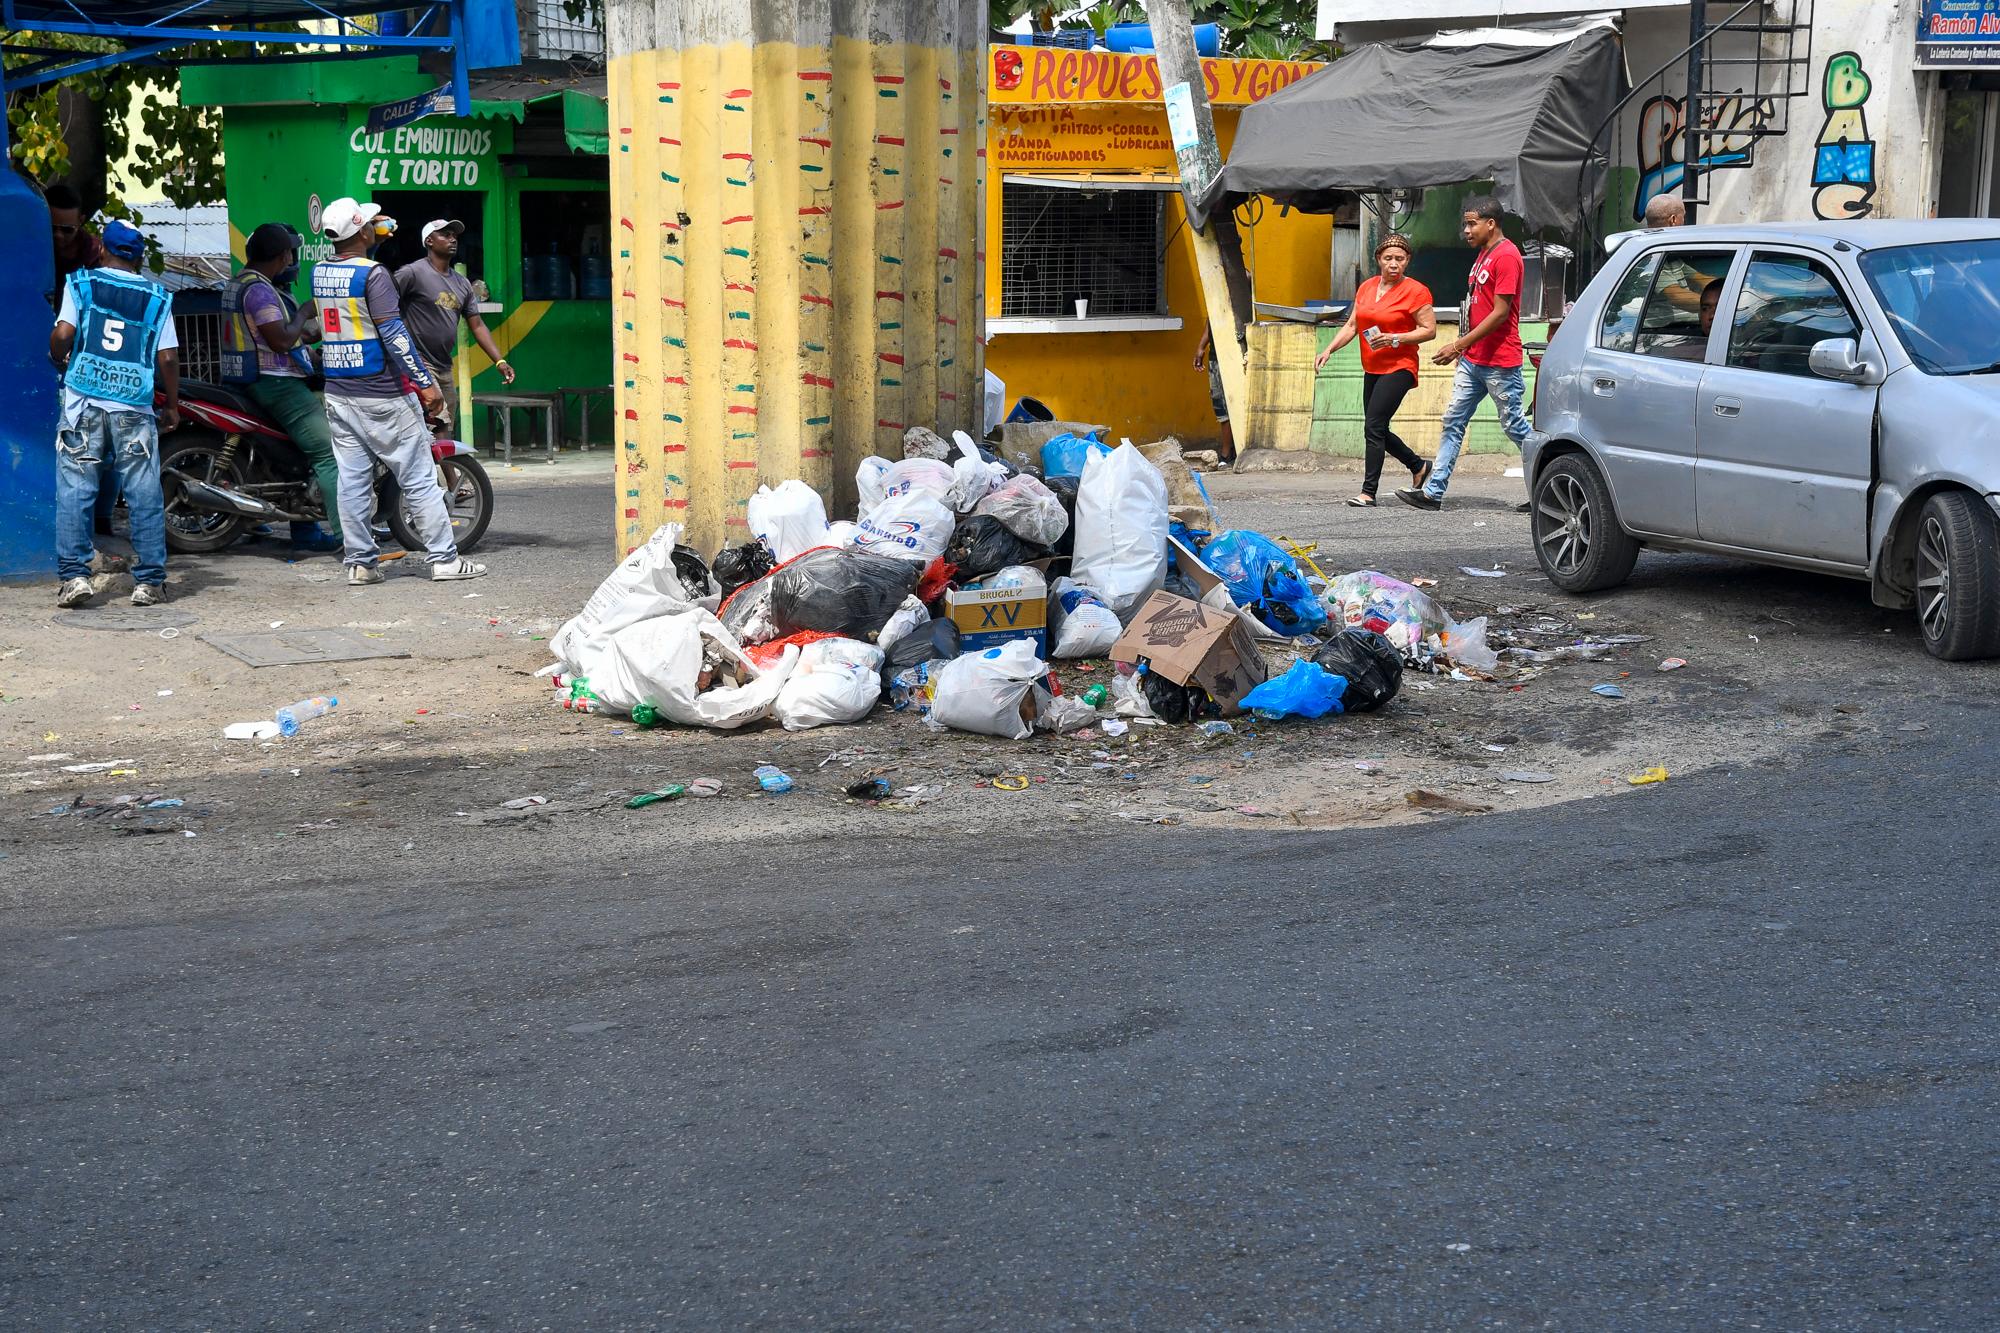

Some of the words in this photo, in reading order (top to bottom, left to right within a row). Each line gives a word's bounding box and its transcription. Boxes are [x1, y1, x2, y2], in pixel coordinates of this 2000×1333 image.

[1984, 2, 1995, 10] de
[1930, 13, 1977, 34] Ramón
[1930, 47, 1935, 58] La
[1232, 62, 1247, 95] Y
[383, 100, 417, 121] CALLE
[394, 126, 492, 156] EMBUTIDOS
[1008, 135, 1051, 149] BANDA
[365, 158, 390, 185] EL
[399, 159, 479, 186] TORITO
[328, 308, 336, 326] 9
[102, 318, 124, 352] 5
[81, 356, 140, 374] PARADA
[76, 364, 86, 376] EL
[93, 368, 142, 388] TORITO
[860, 520, 917, 548] GARRIDO
[980, 590, 1013, 600] BRUGAL
[980, 603, 1022, 628] XV
[1154, 615, 1196, 630] morena
[1156, 622, 1188, 636] malta
